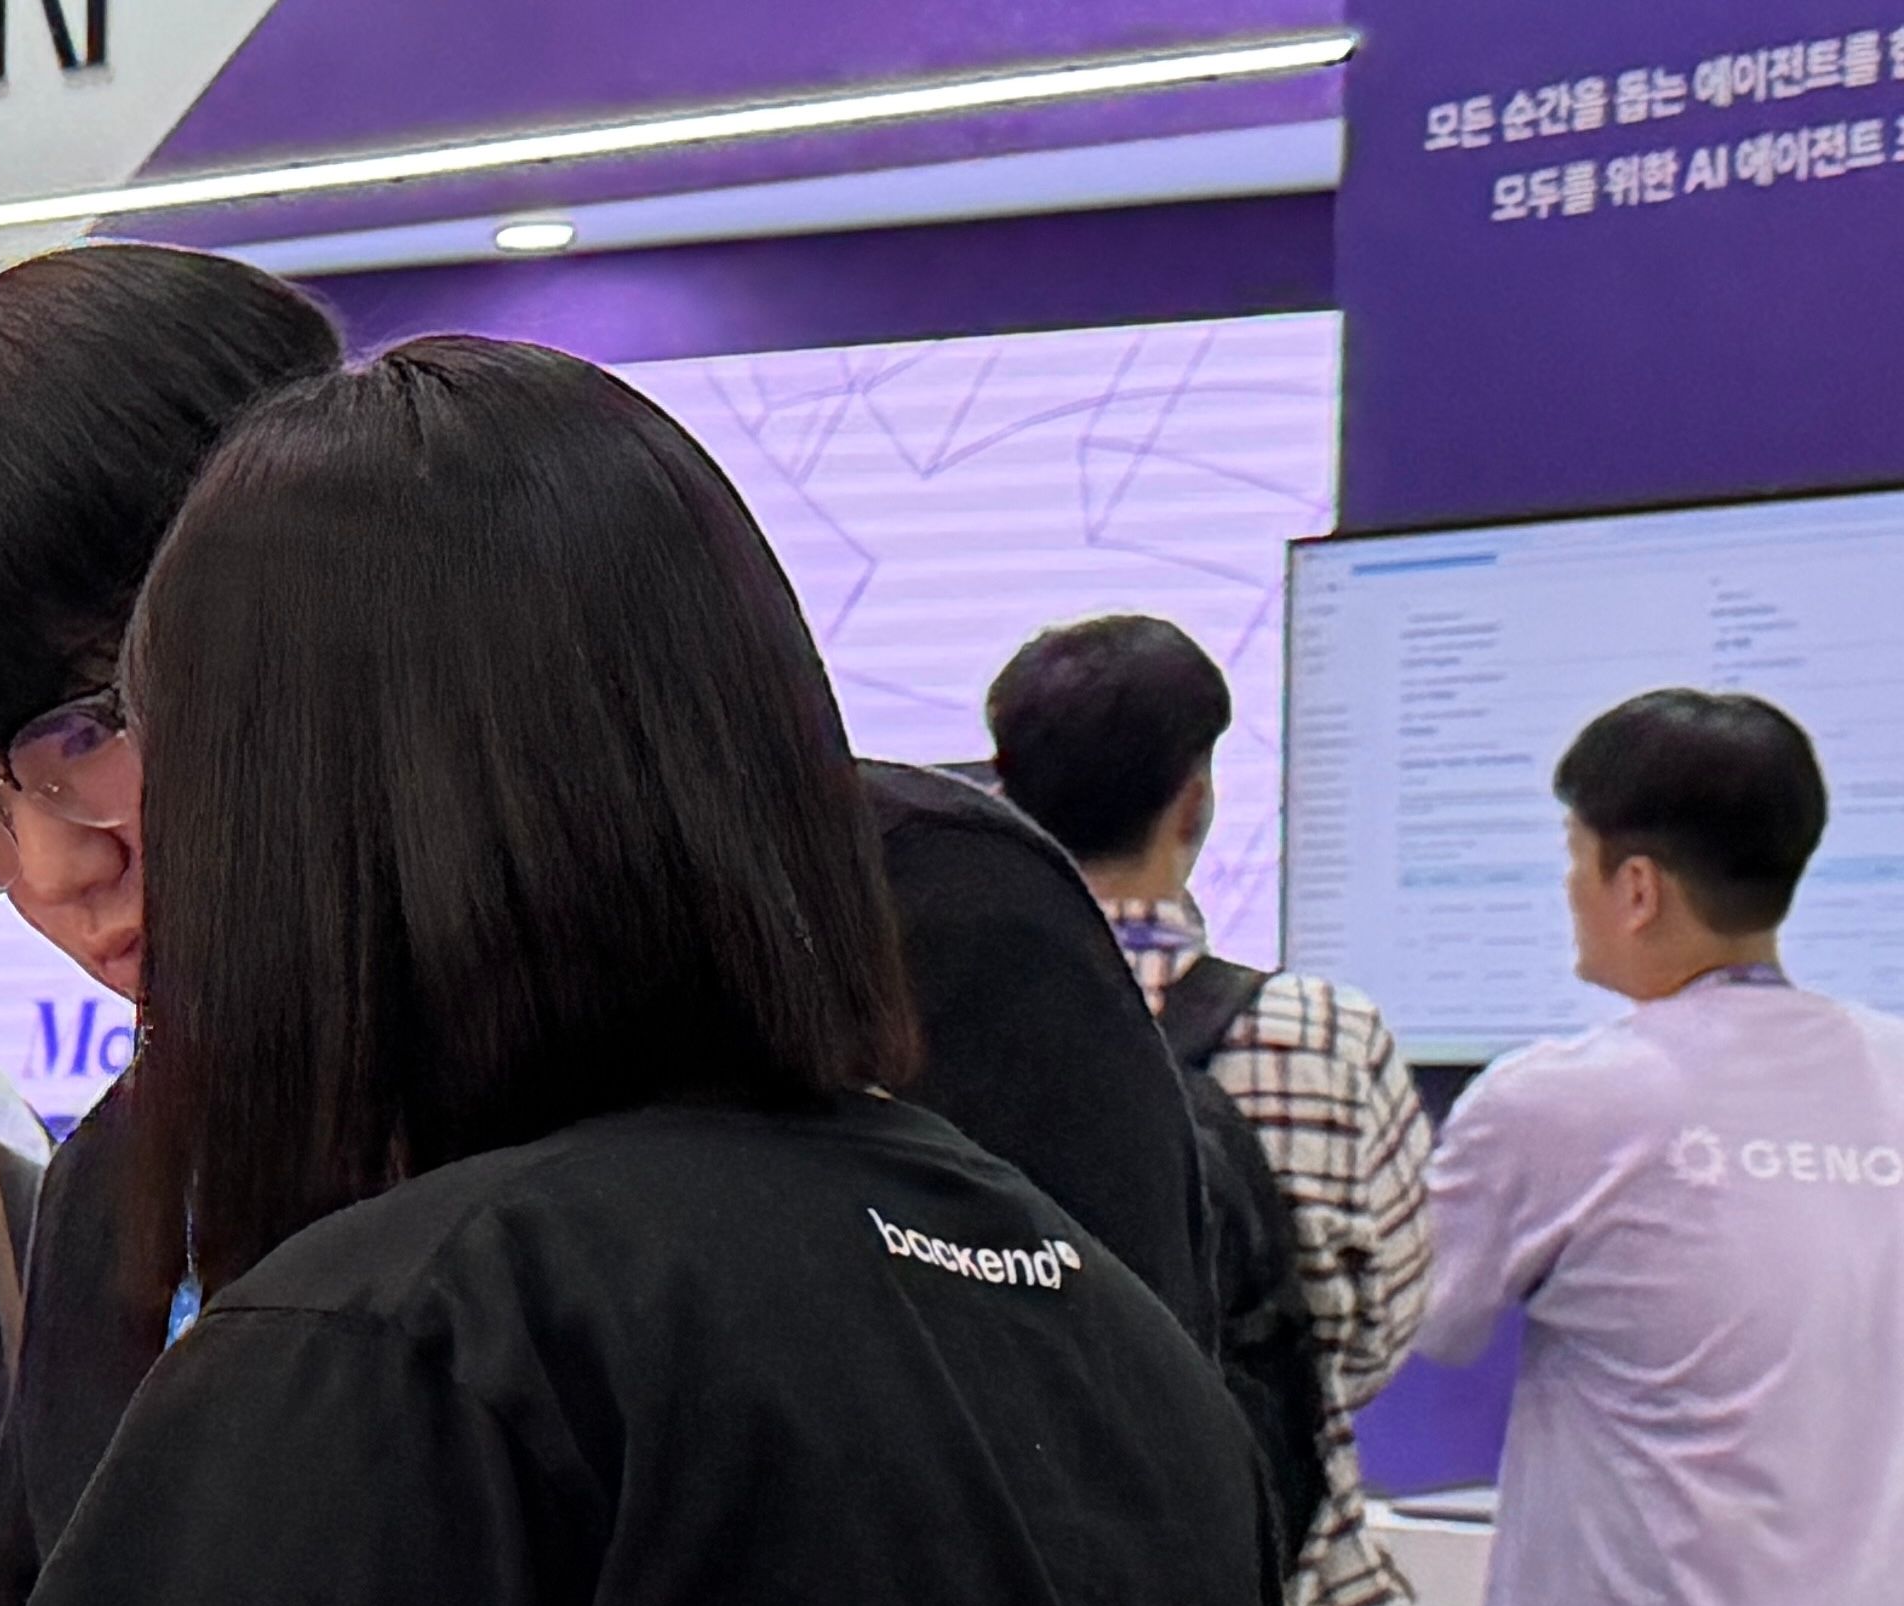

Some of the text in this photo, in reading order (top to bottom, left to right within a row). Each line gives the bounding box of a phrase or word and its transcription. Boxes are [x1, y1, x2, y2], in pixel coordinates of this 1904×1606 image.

[1424, 28, 1881, 151] 모든 순간을 돕는 에이전트를
[1491, 117, 1885, 221] 모두를 위한 AI 에이전트
[866, 1207, 1062, 1291] backend
